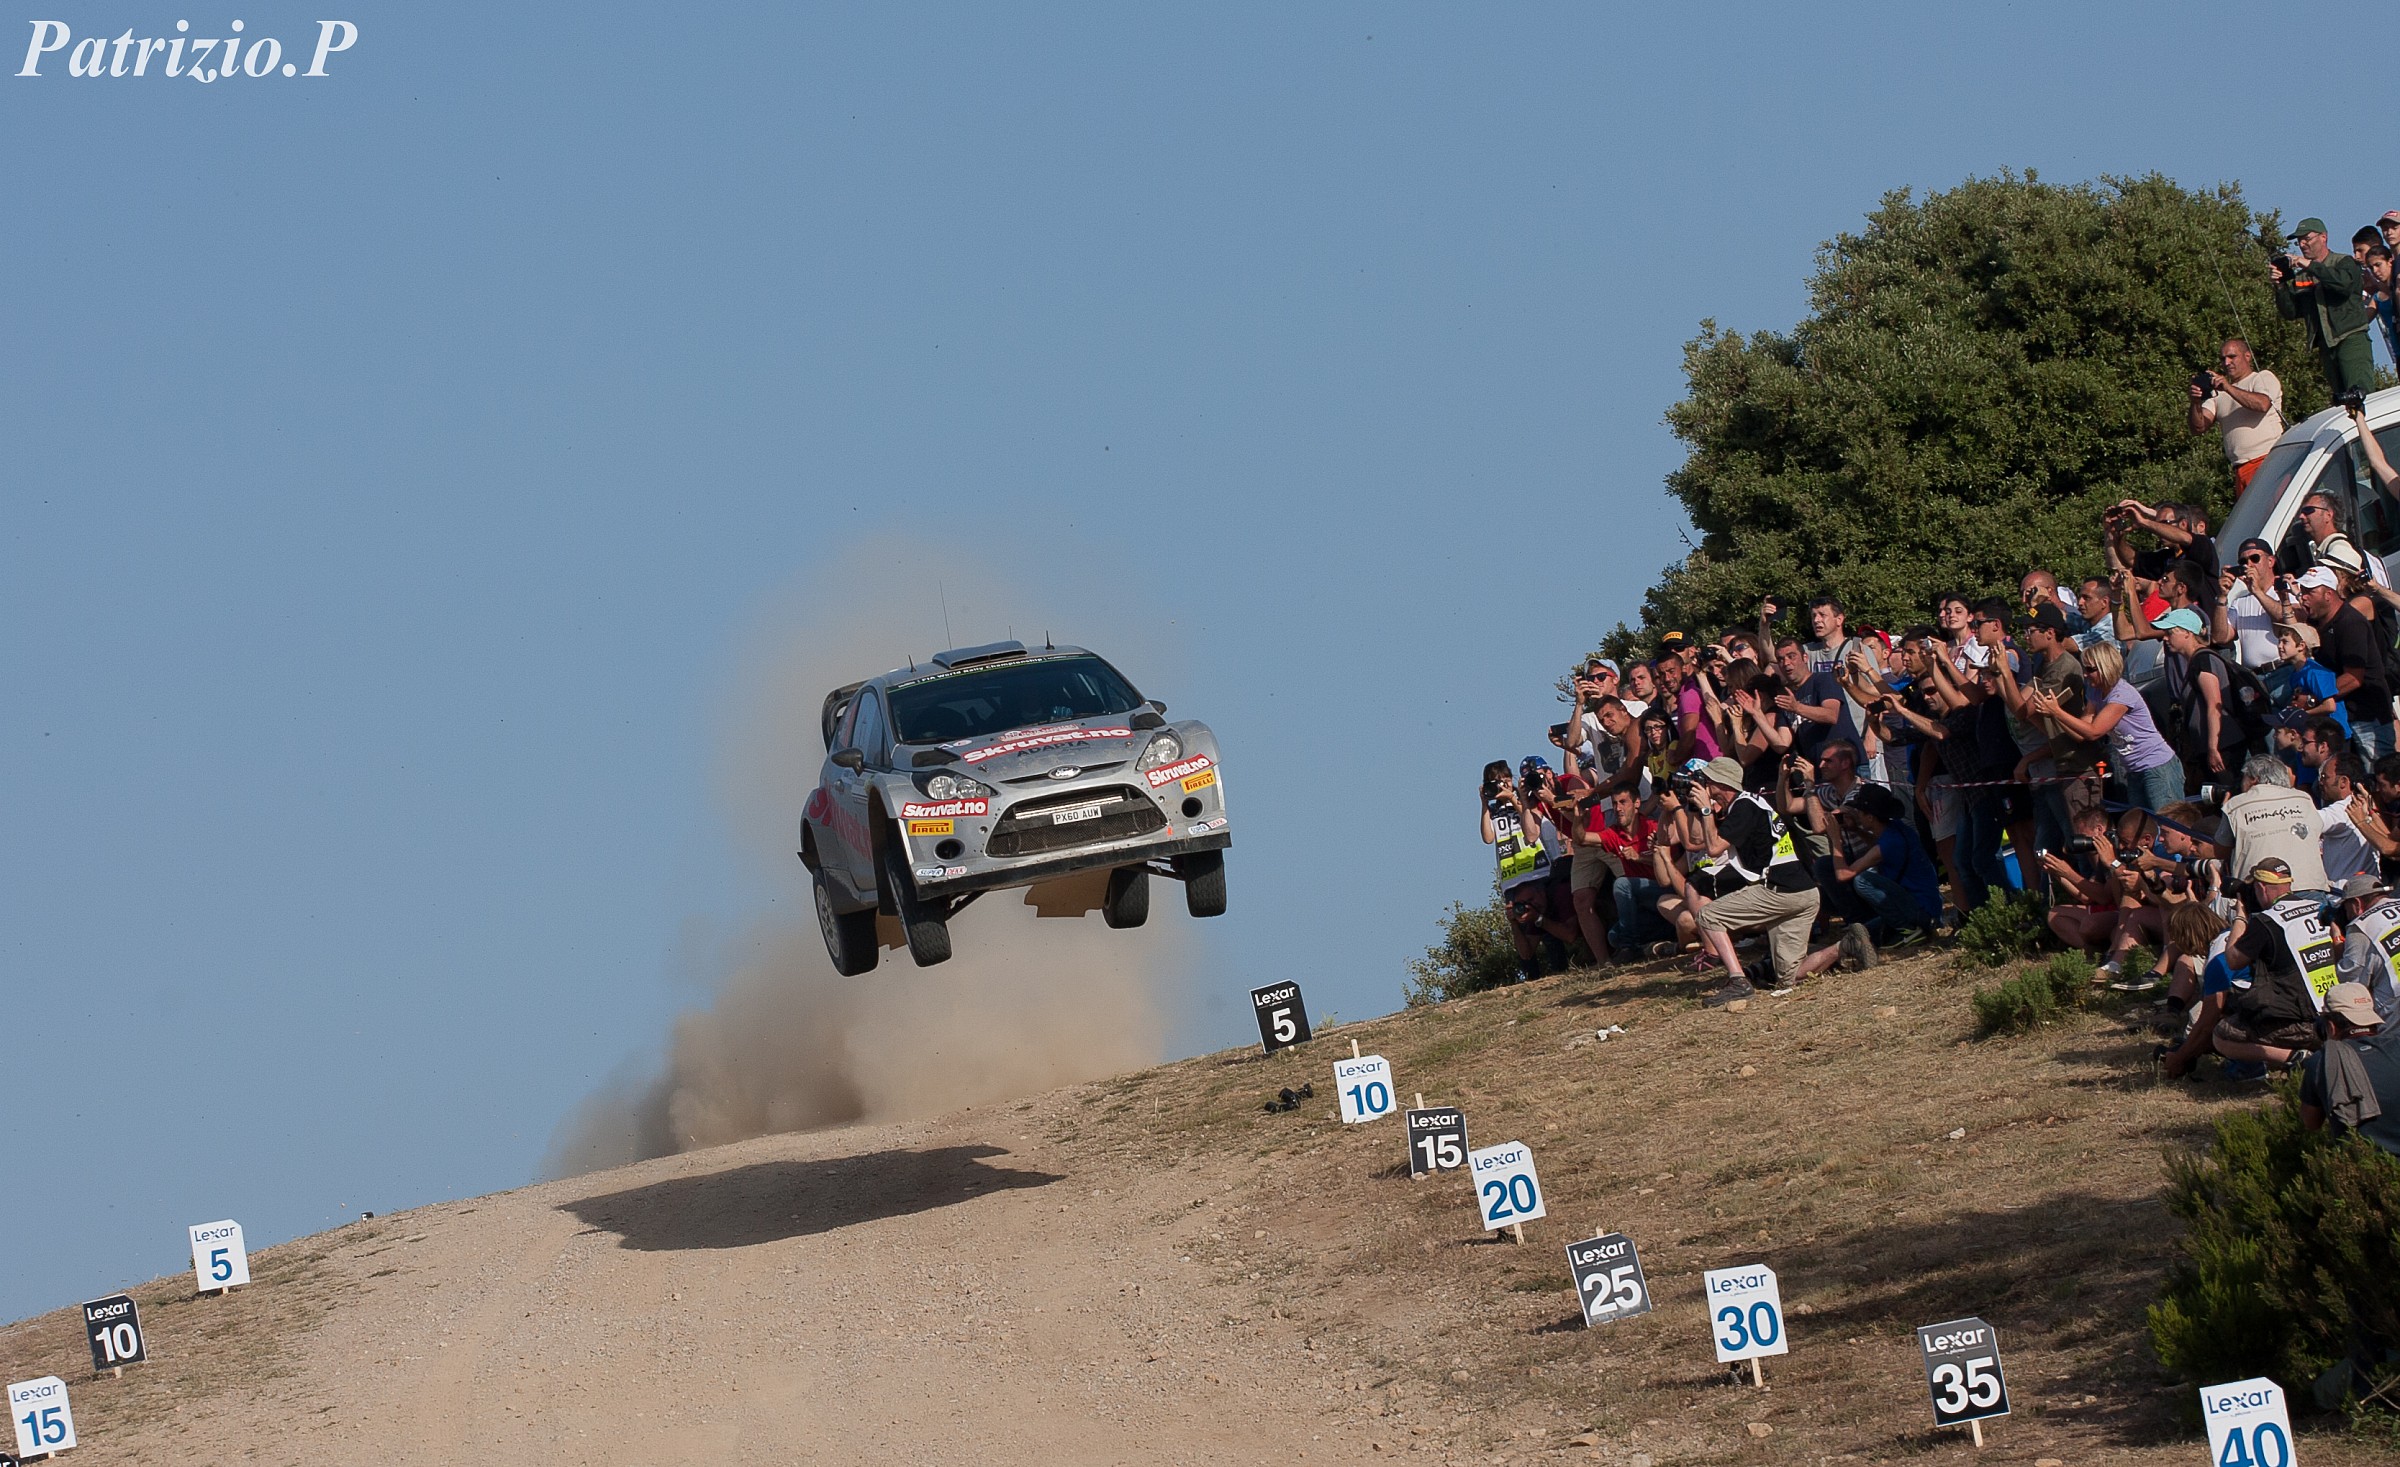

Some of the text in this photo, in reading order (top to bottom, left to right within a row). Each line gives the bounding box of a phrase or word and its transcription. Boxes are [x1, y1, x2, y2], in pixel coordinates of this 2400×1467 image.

[963, 728, 1131, 762] Skruvat.no
[1148, 757, 1209, 785] Skruvat.no
[1185, 773, 1214, 790] PIRELLI
[903, 801, 986, 817] Skruvat.no
[1055, 807, 1100, 823] PX60 AUW
[911, 822, 950, 833] PIRELLI
[2303, 949, 2331, 963] Lexar
[1254, 985, 1296, 1007] Lexar
[1272, 1007, 1296, 1043] 5
[1339, 1061, 1383, 1078] Lexar
[1346, 1081, 1388, 1116] 10
[1411, 1113, 1459, 1129] Lexar
[1417, 1134, 1462, 1169] 15
[1474, 1148, 1524, 1172] Lexar
[1483, 1174, 1537, 1221] 20
[195, 1226, 235, 1242] Lexar
[211, 1248, 233, 1281] 5
[1573, 1241, 1627, 1266] Lexar
[1583, 1265, 1642, 1316] 25
[1711, 1273, 1767, 1294] Lexar
[87, 1302, 130, 1321] Lexar
[1717, 1301, 1779, 1351] 30
[95, 1323, 138, 1362] 10
[1923, 1328, 1986, 1353] Lexar
[13, 1384, 58, 1403] Lexar
[1932, 1357, 2001, 1414] 35
[2207, 1389, 2273, 1414] Lexar
[21, 1406, 67, 1447] 15
[2218, 1422, 2289, 1467] 40
